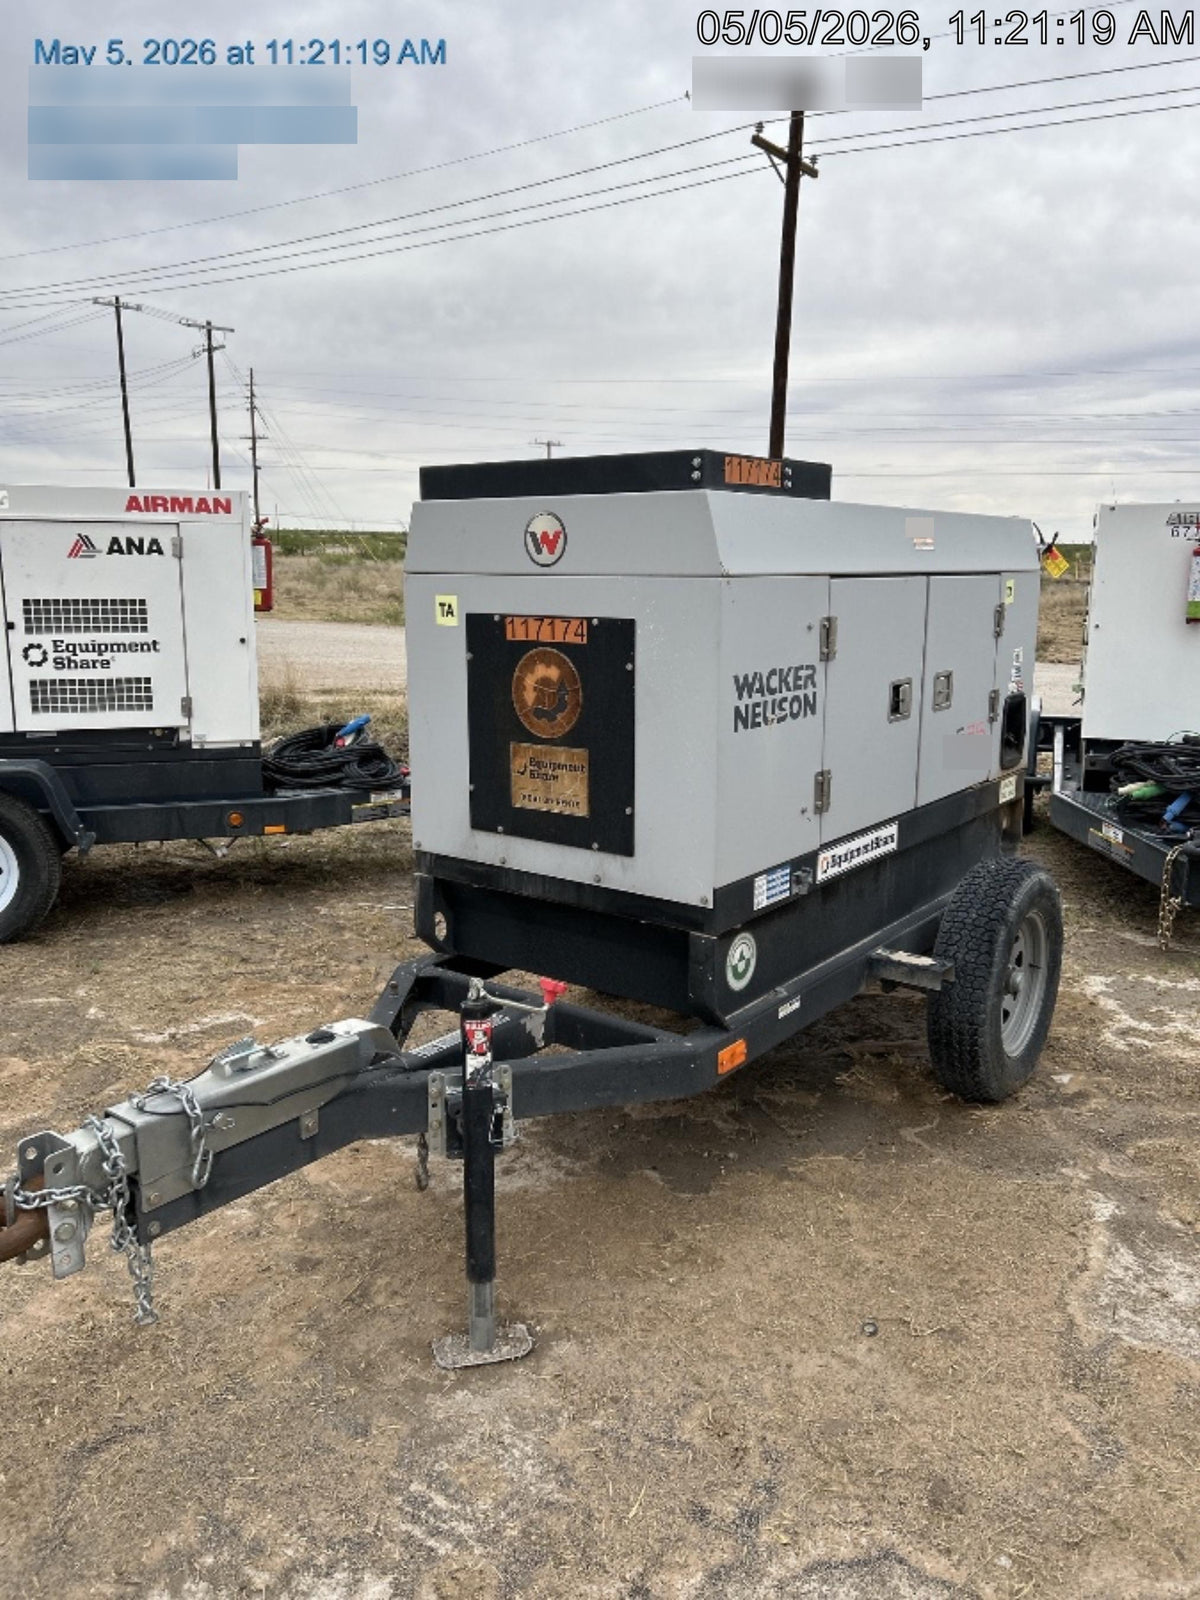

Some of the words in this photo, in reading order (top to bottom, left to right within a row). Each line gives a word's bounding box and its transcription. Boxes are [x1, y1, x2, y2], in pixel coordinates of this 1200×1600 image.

[726, 457, 780, 485] 117174
[125, 495, 232, 514] AIRMAN
[106, 536, 164, 555] ANA
[438, 602, 455, 618] TA
[508, 617, 586, 642] 117174
[51, 639, 161, 656] Equipment
[732, 664, 817, 701] WACKER
[733, 691, 817, 733] NEUSON
